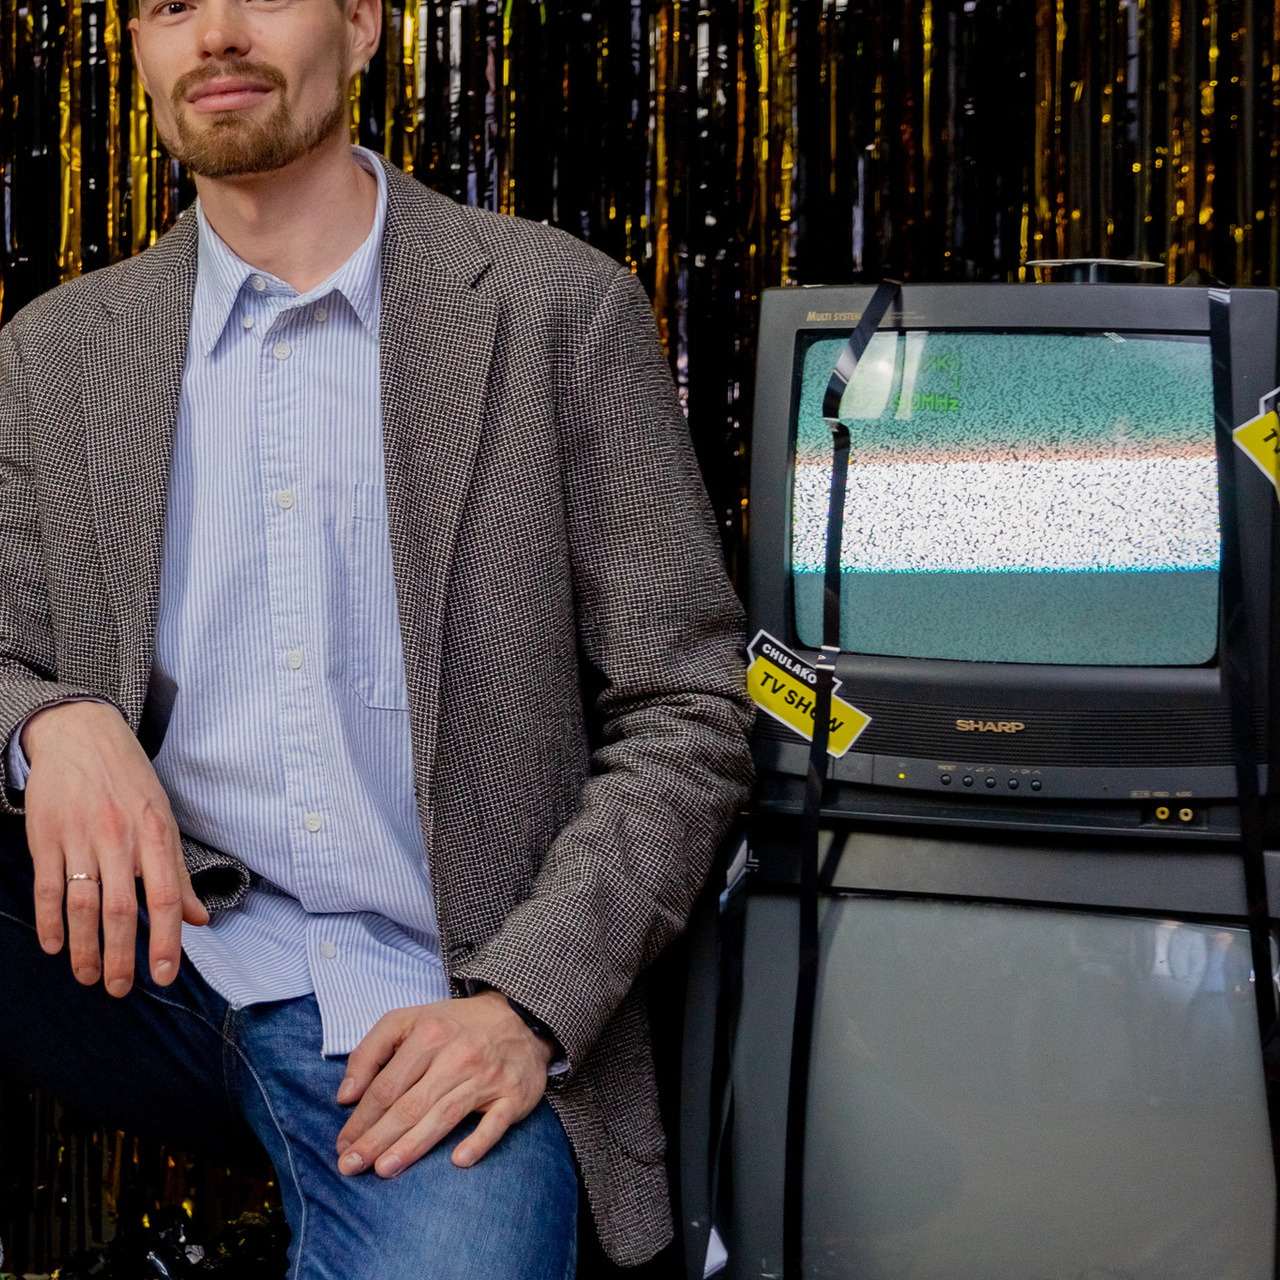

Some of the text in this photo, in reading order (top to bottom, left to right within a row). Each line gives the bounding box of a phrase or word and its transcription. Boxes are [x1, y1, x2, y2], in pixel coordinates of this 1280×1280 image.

[761, 643, 818, 685] CHULAKO
[760, 671, 786, 694] TV
[955, 719, 1026, 734] SHARP
